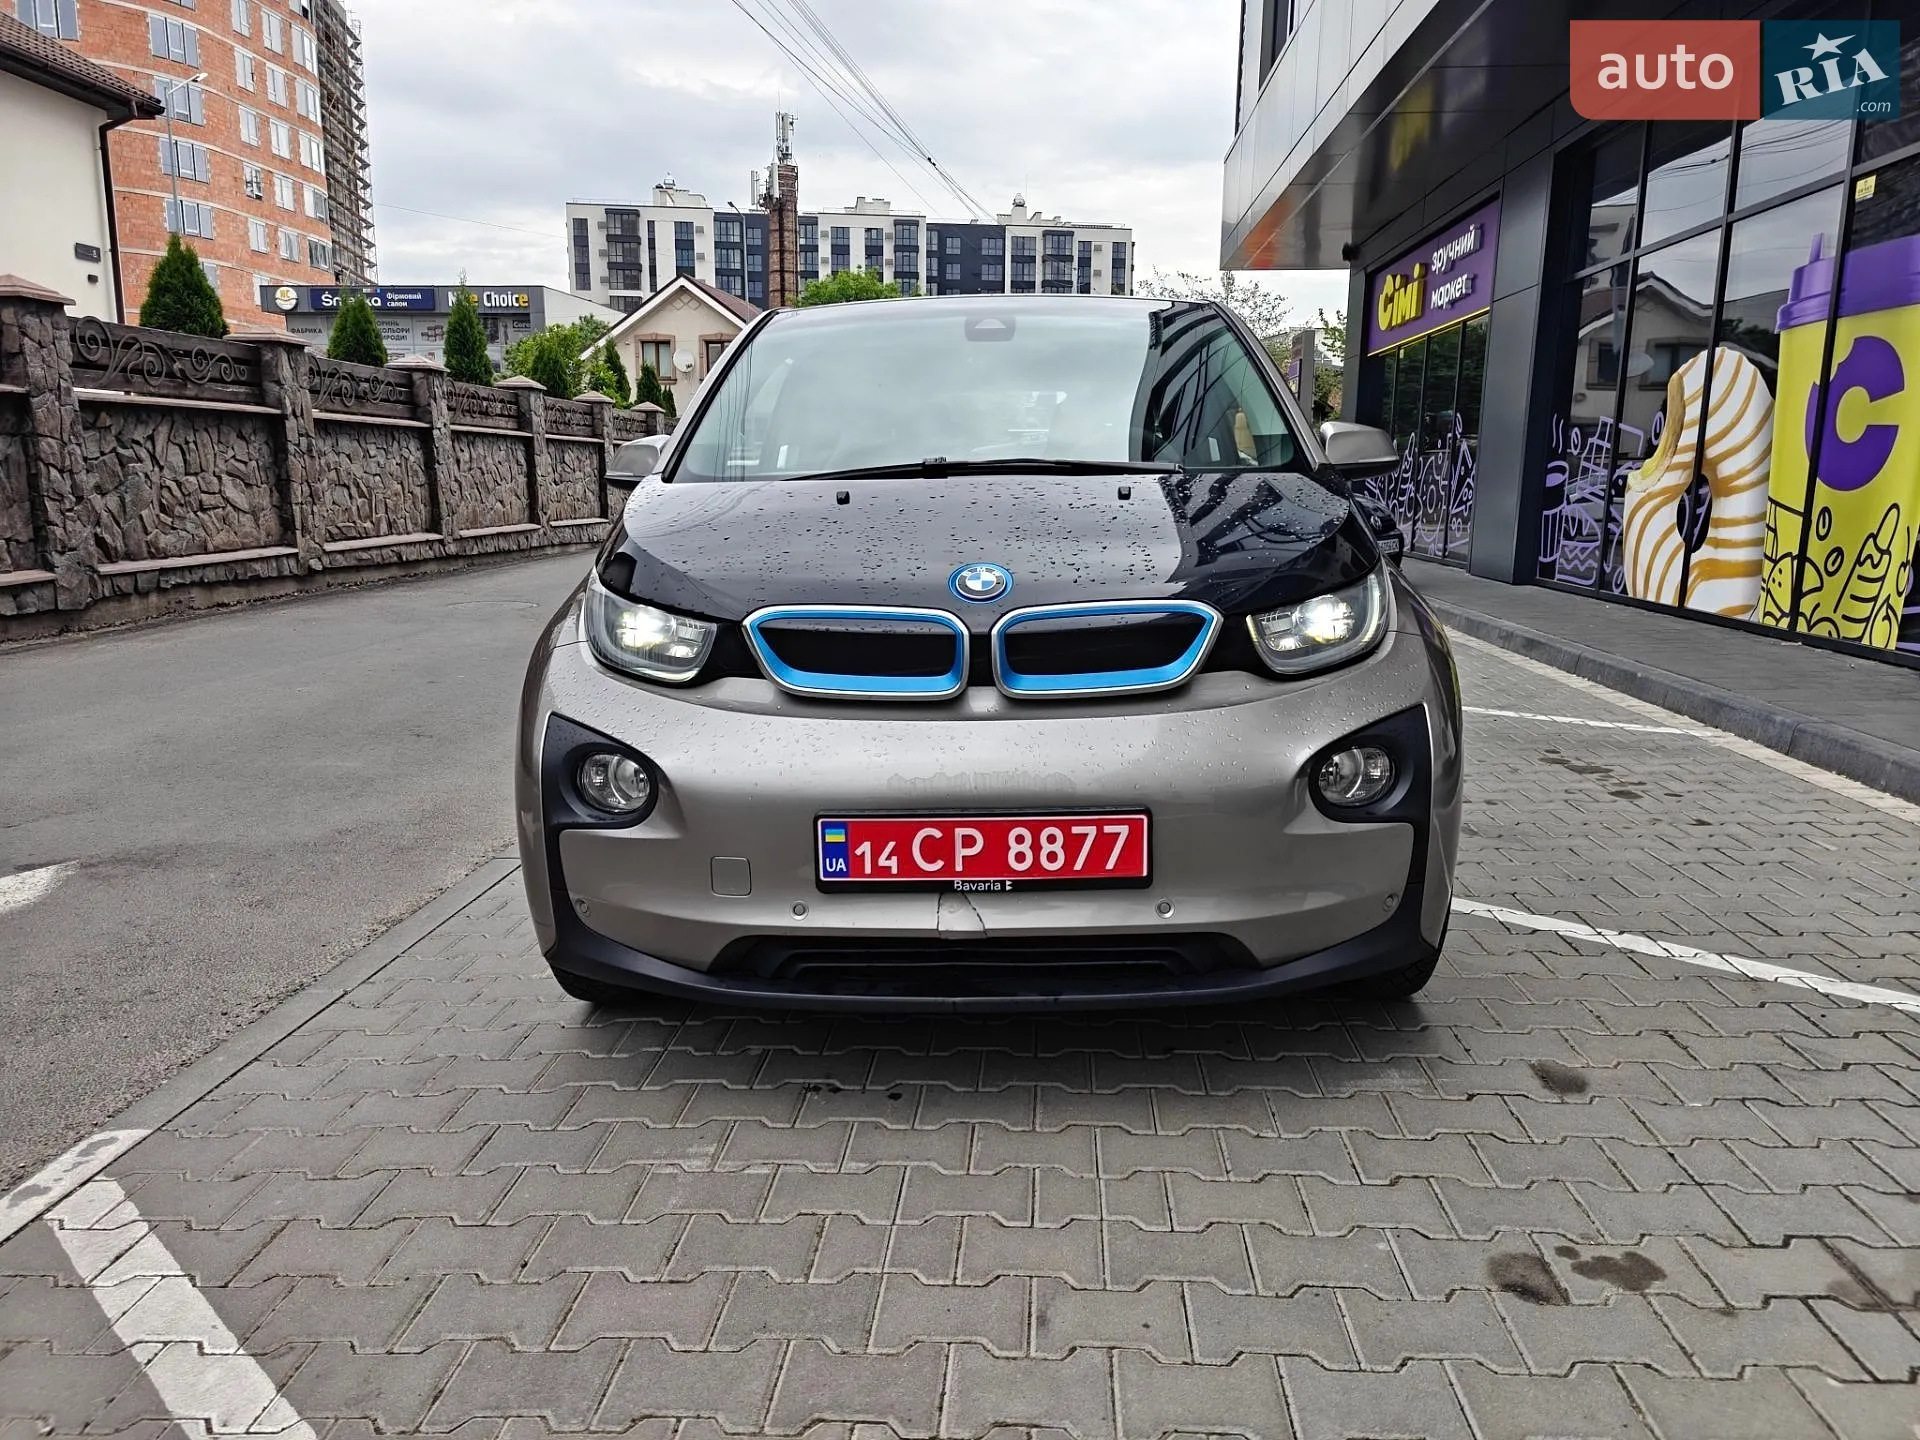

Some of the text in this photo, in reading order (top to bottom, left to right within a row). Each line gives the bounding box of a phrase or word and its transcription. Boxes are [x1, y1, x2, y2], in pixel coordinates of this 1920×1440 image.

[1431, 224, 1476, 274] зручний
[386, 292, 421, 300] Фірмовий
[484, 291, 528, 307] Choice
[1431, 273, 1468, 309] маркет
[854, 824, 1131, 875] 14 CP 8877
[825, 857, 847, 873] UA
[953, 879, 1002, 892] Bavaria
